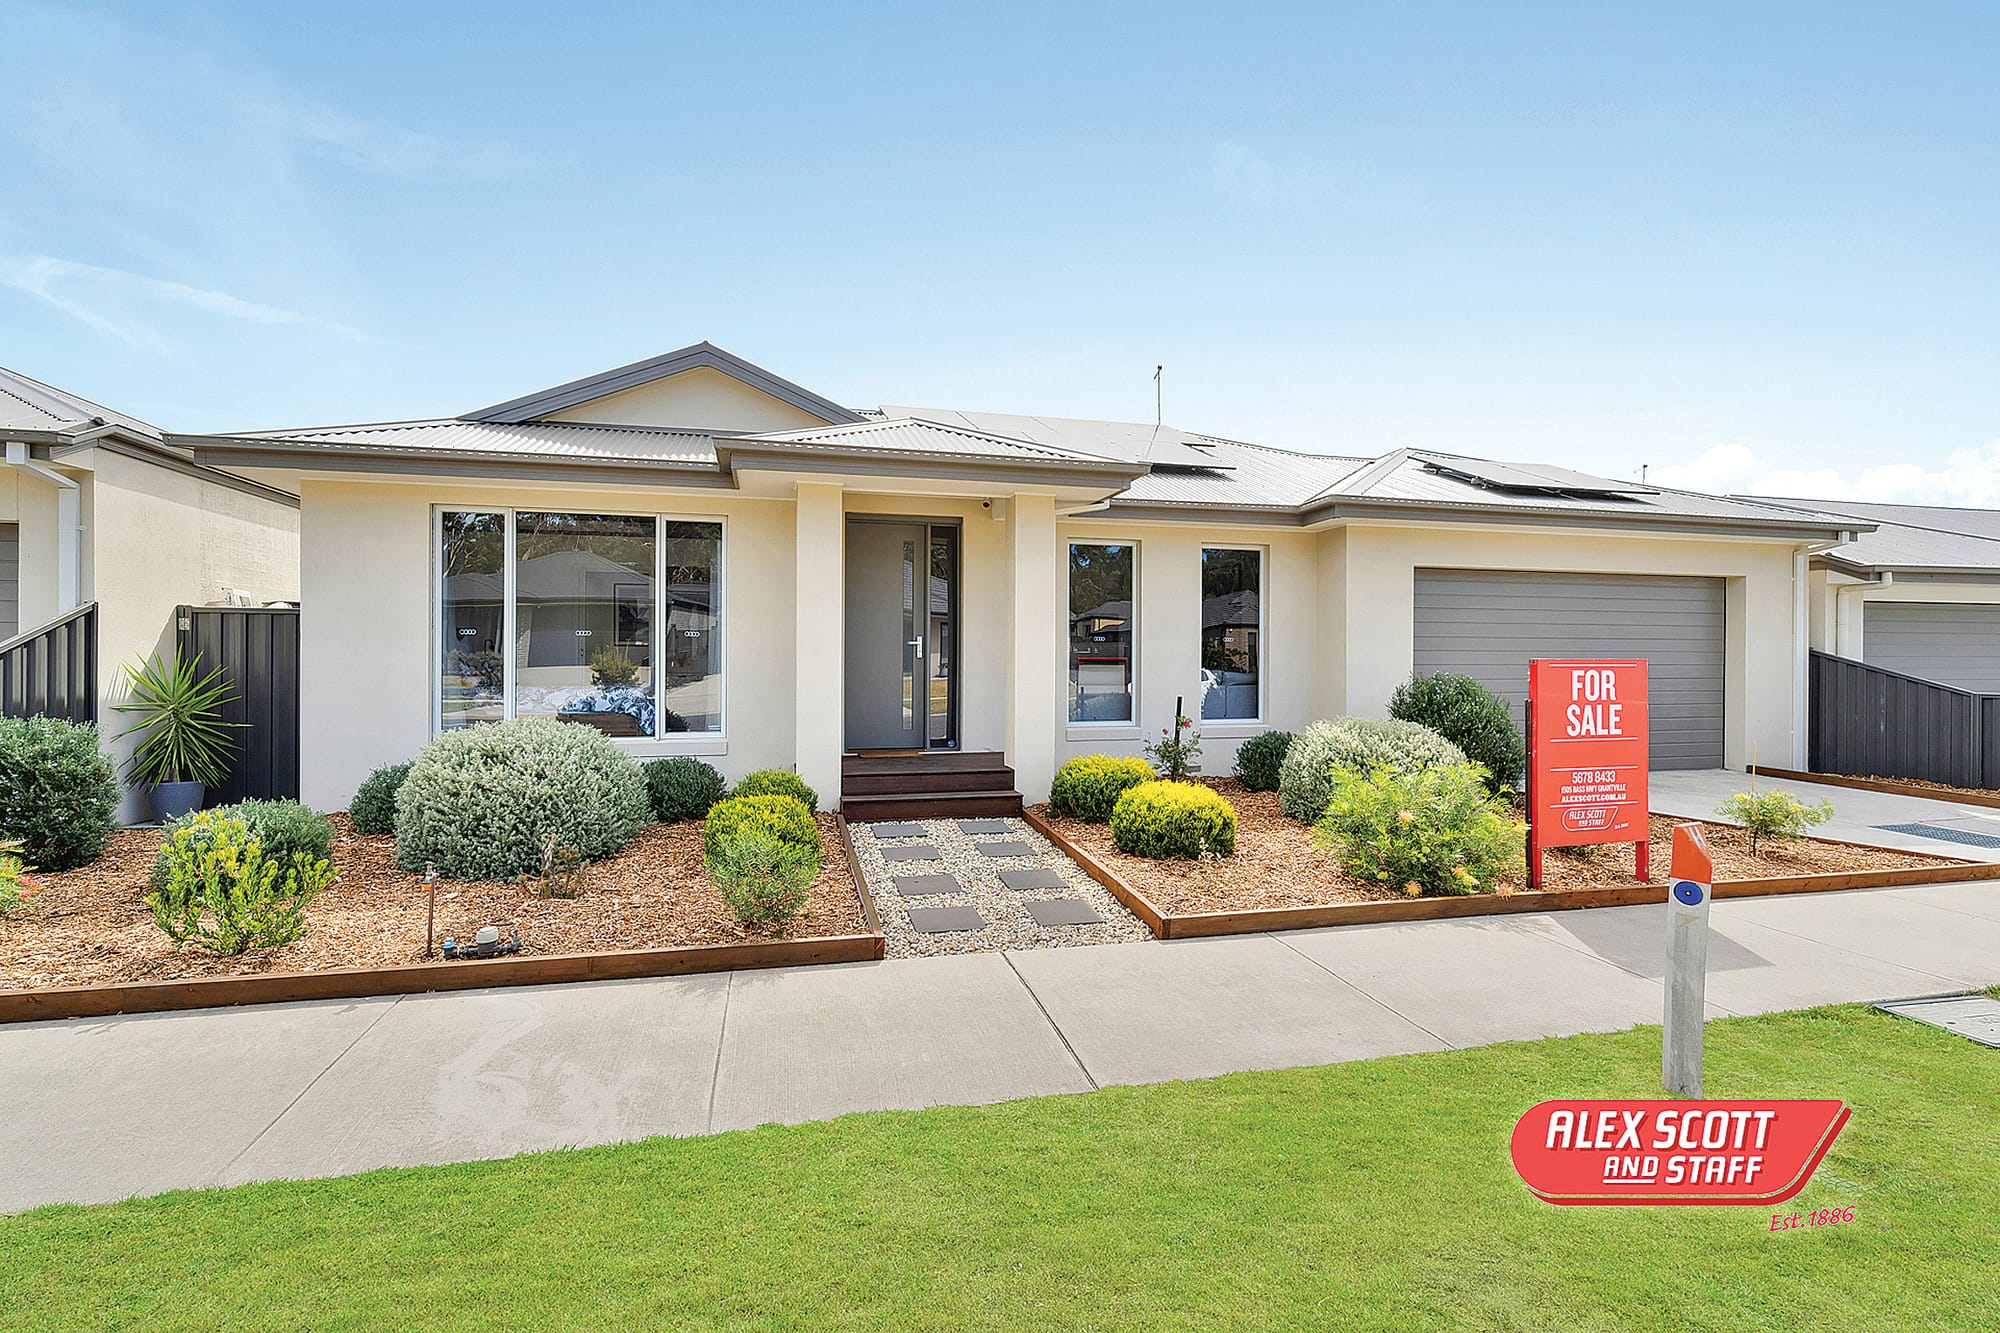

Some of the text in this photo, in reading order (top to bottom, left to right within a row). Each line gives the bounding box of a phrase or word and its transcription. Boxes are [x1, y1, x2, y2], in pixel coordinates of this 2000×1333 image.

[1572, 669, 1617, 701] FOR
[1566, 704, 1622, 736] SALE
[1572, 770, 1616, 784] 5678 8433
[1573, 785, 1585, 793] BASS
[1586, 784, 1597, 792] HWY
[1597, 783, 1626, 792] GRANTVILLE
[1561, 793, 1626, 803] ALEXSCOTT.COM.AU
[1569, 809, 1607, 820] ALEX SCOTT
